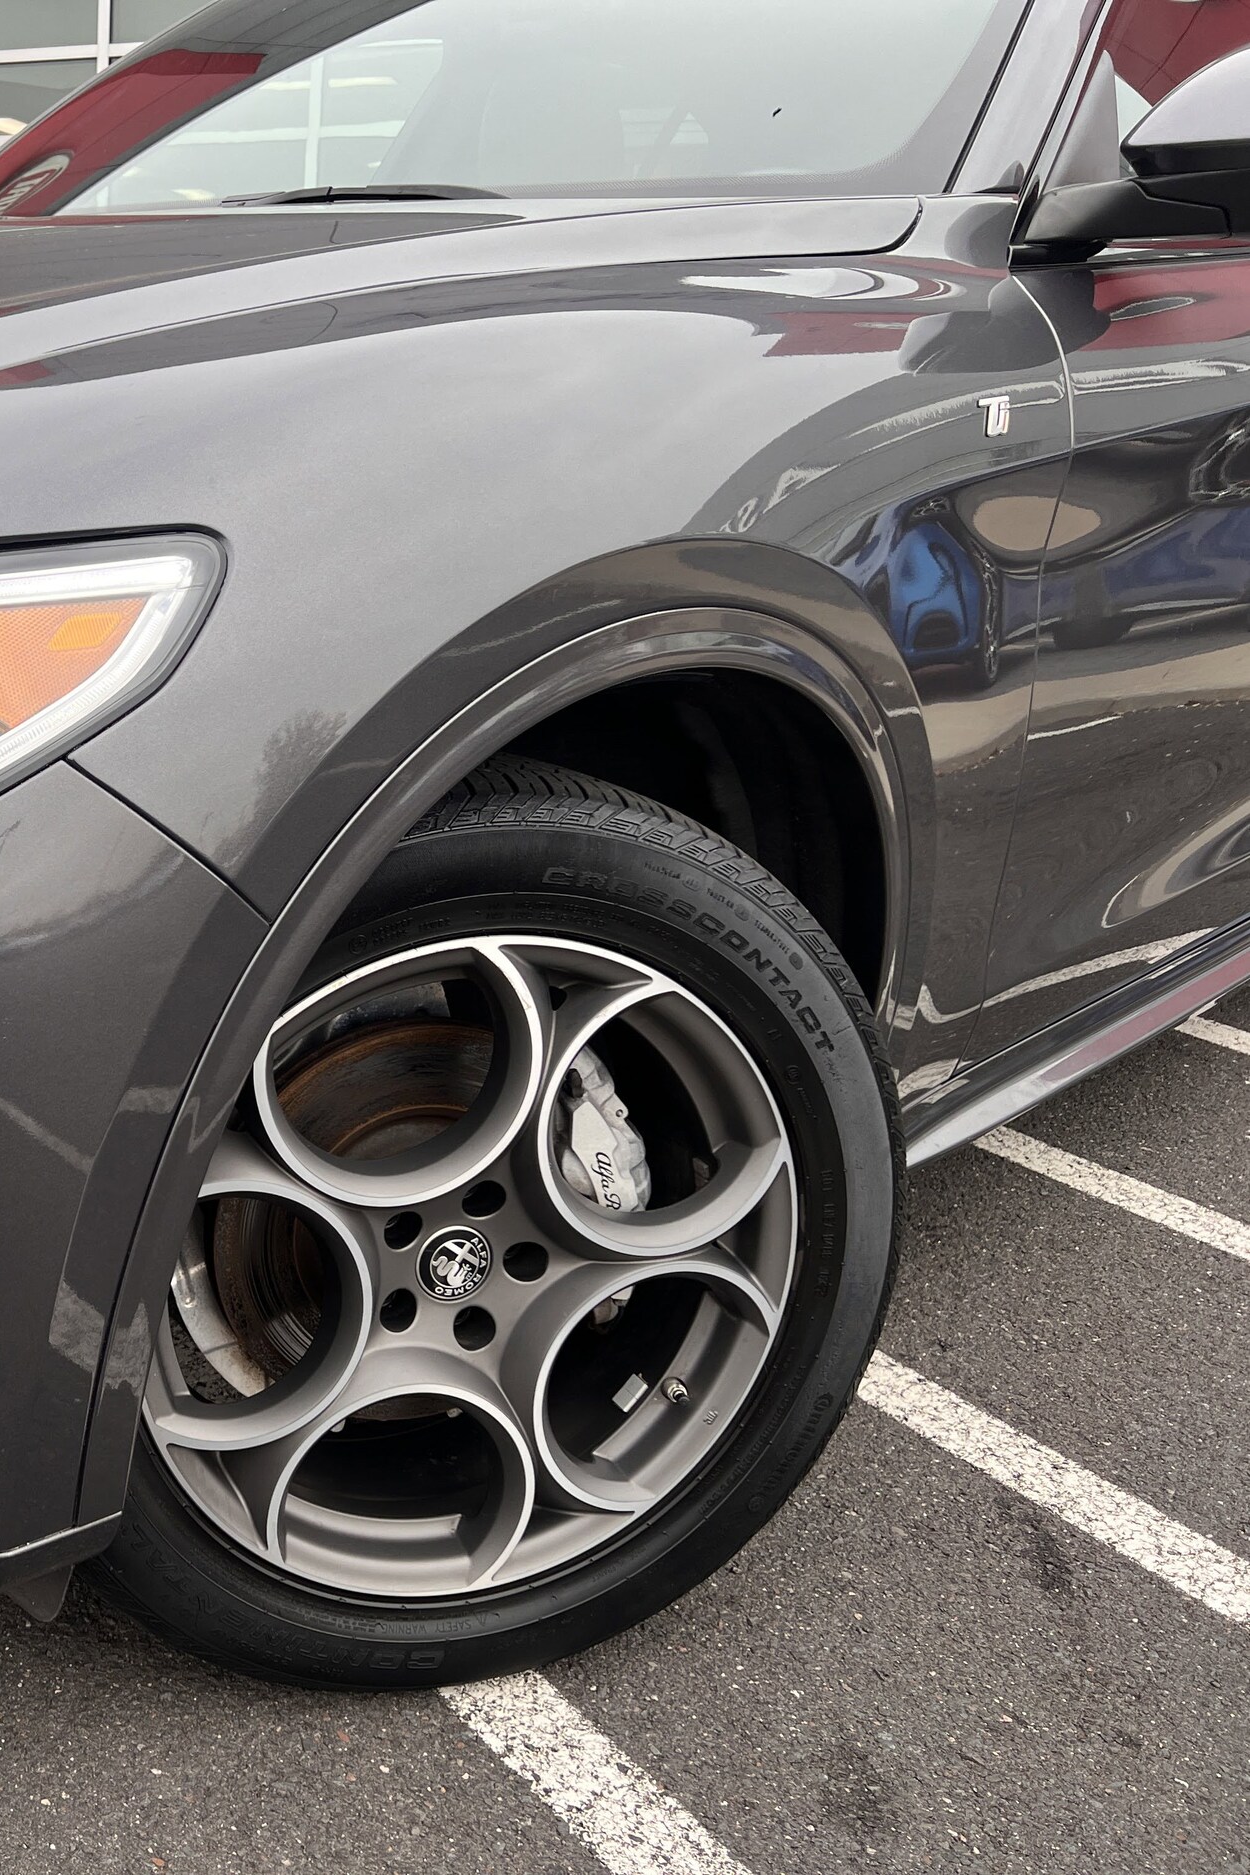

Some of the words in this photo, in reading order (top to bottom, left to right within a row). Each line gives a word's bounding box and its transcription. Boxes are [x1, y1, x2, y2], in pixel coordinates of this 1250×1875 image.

[541, 865, 835, 1053] CROSSCONTACT
[591, 1151, 616, 1193] Alfa
[470, 1237, 487, 1268] ALFA
[434, 1273, 482, 1296] ROMEO
[381, 1622, 428, 1635] WARNING
[435, 1618, 472, 1635] SAFETY
